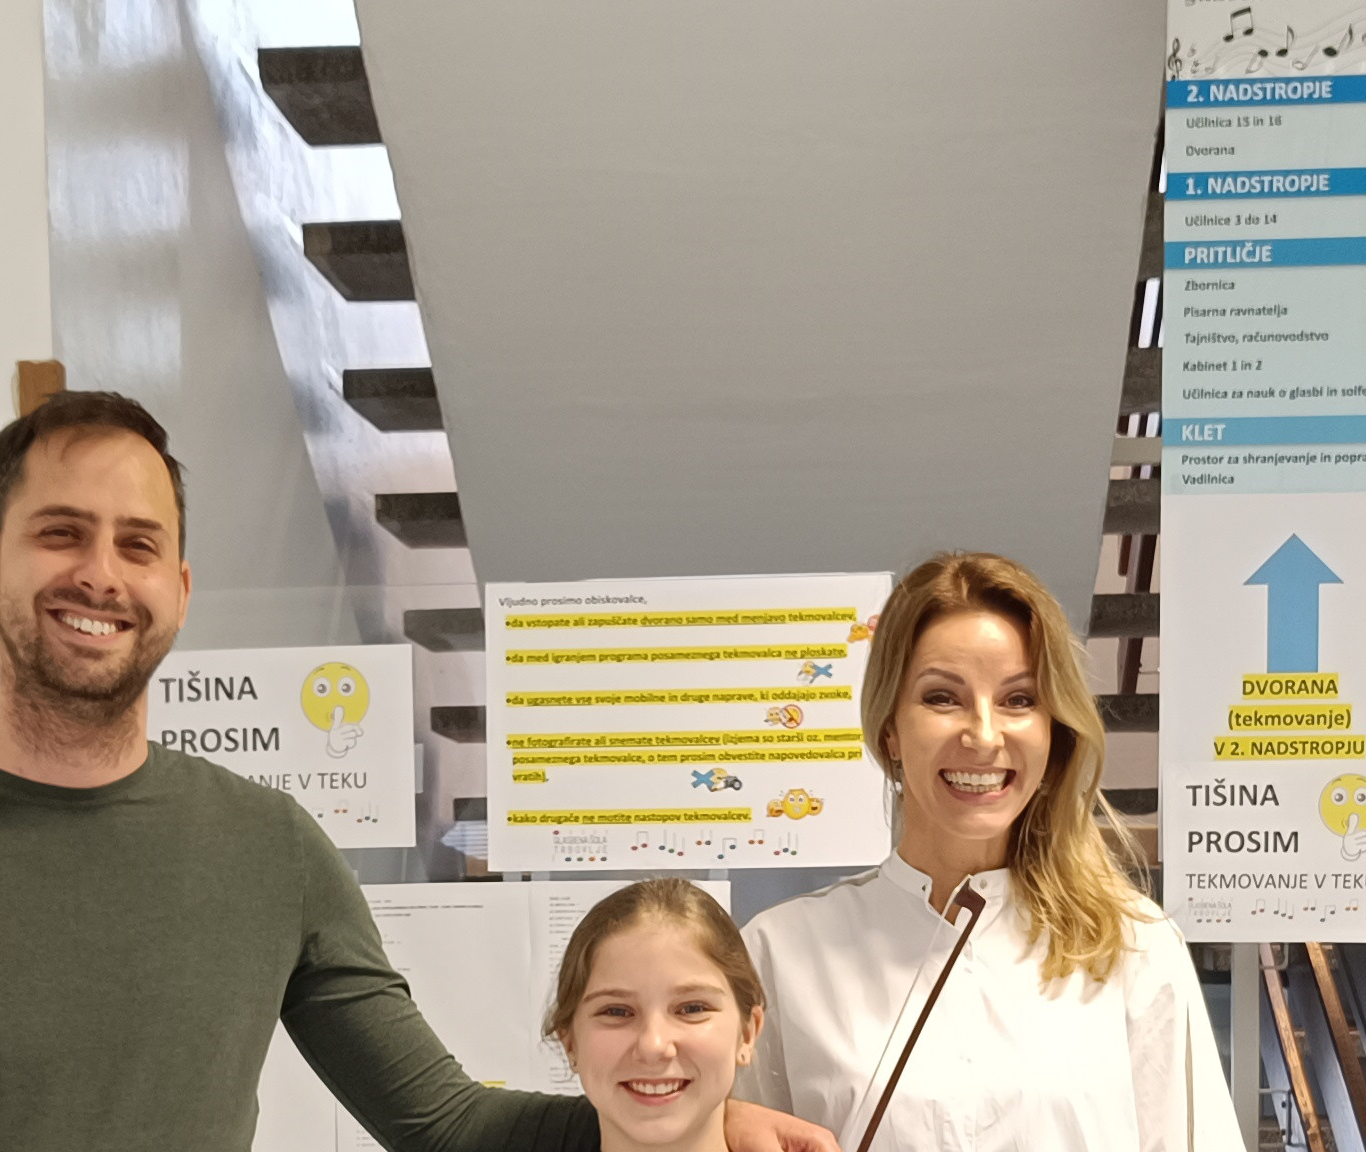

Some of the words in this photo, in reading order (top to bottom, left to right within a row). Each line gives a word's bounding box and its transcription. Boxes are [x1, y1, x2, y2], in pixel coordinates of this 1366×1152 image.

[1187, 86, 1204, 102] 2.
[1210, 81, 1333, 101] NADSTROPJE
[1186, 116, 1232, 128] Učilnica
[1253, 115, 1264, 126] in
[1186, 145, 1235, 156] Dvorana
[1186, 177, 1202, 195] 1.
[1208, 174, 1330, 194] NADSTROPJE
[1185, 215, 1231, 227] Učilnice
[1245, 214, 1260, 225] do
[1264, 214, 1277, 225] 14
[1185, 242, 1272, 264] PRITLIČJE
[1185, 279, 1235, 291] Zbornica
[1183, 306, 1226, 318] Pisarna
[1230, 304, 1288, 318] ravnatelja
[1185, 332, 1239, 346] Tajništvo,
[1242, 330, 1329, 343] računovodstvo
[1183, 360, 1227, 372] Kabinet
[1231, 360, 1237, 371] 1
[1241, 360, 1252, 371] in
[1256, 360, 1262, 371] 2
[1183, 387, 1227, 400] Učilnica
[1231, 389, 1243, 399] za
[1247, 387, 1275, 399] nauk
[1279, 388, 1286, 398] o
[1289, 386, 1323, 400] glasbi
[1327, 386, 1337, 397] in
[1181, 423, 1226, 441] KLET
[1181, 454, 1224, 465] Prostor
[1227, 456, 1239, 465] za
[1243, 452, 1317, 466] shranjevanje
[1321, 452, 1332, 463] in
[1182, 473, 1234, 485] Vadilnica
[541, 596, 582, 607] prosimo
[526, 618, 570, 628] vstopate
[573, 617, 585, 627] ali
[640, 615, 683, 626] dvorano
[686, 616, 713, 625] samo
[716, 614, 739, 624] med
[526, 653, 549, 662] med
[599, 652, 648, 663] programa
[723, 649, 782, 659] tekmovalca
[786, 650, 797, 658] ne
[159, 670, 258, 703] TIŠINA
[1243, 679, 1338, 695] DVORANA
[595, 694, 620, 705] svoje
[624, 693, 665, 703] mobilne
[669, 692, 678, 702] in
[680, 692, 710, 703] druge
[760, 691, 769, 700] ki
[772, 691, 816, 701] oddajajo
[1228, 709, 1352, 730] (tekmovanje)
[161, 727, 280, 753] PROSIM
[656, 733, 720, 745] tekmovalcev
[762, 735, 774, 743] so
[777, 732, 804, 742] starši
[1214, 741, 1225, 755] V
[1230, 741, 1244, 755] 2.
[1251, 740, 1365, 755] NADSTROPJU
[657, 753, 678, 762] tem
[680, 752, 715, 763] prosim
[768, 749, 845, 762] napovedovalca
[298, 773, 311, 790] V
[317, 772, 367, 789] TEKU
[1186, 778, 1279, 806] TIŠINA
[513, 813, 537, 823] kako
[540, 812, 580, 824] drugače
[635, 812, 681, 824] nastopov
[1188, 831, 1299, 853] PROSIM
[1186, 873, 1308, 889] TEKMOVANJE
[1314, 873, 1327, 889] V
